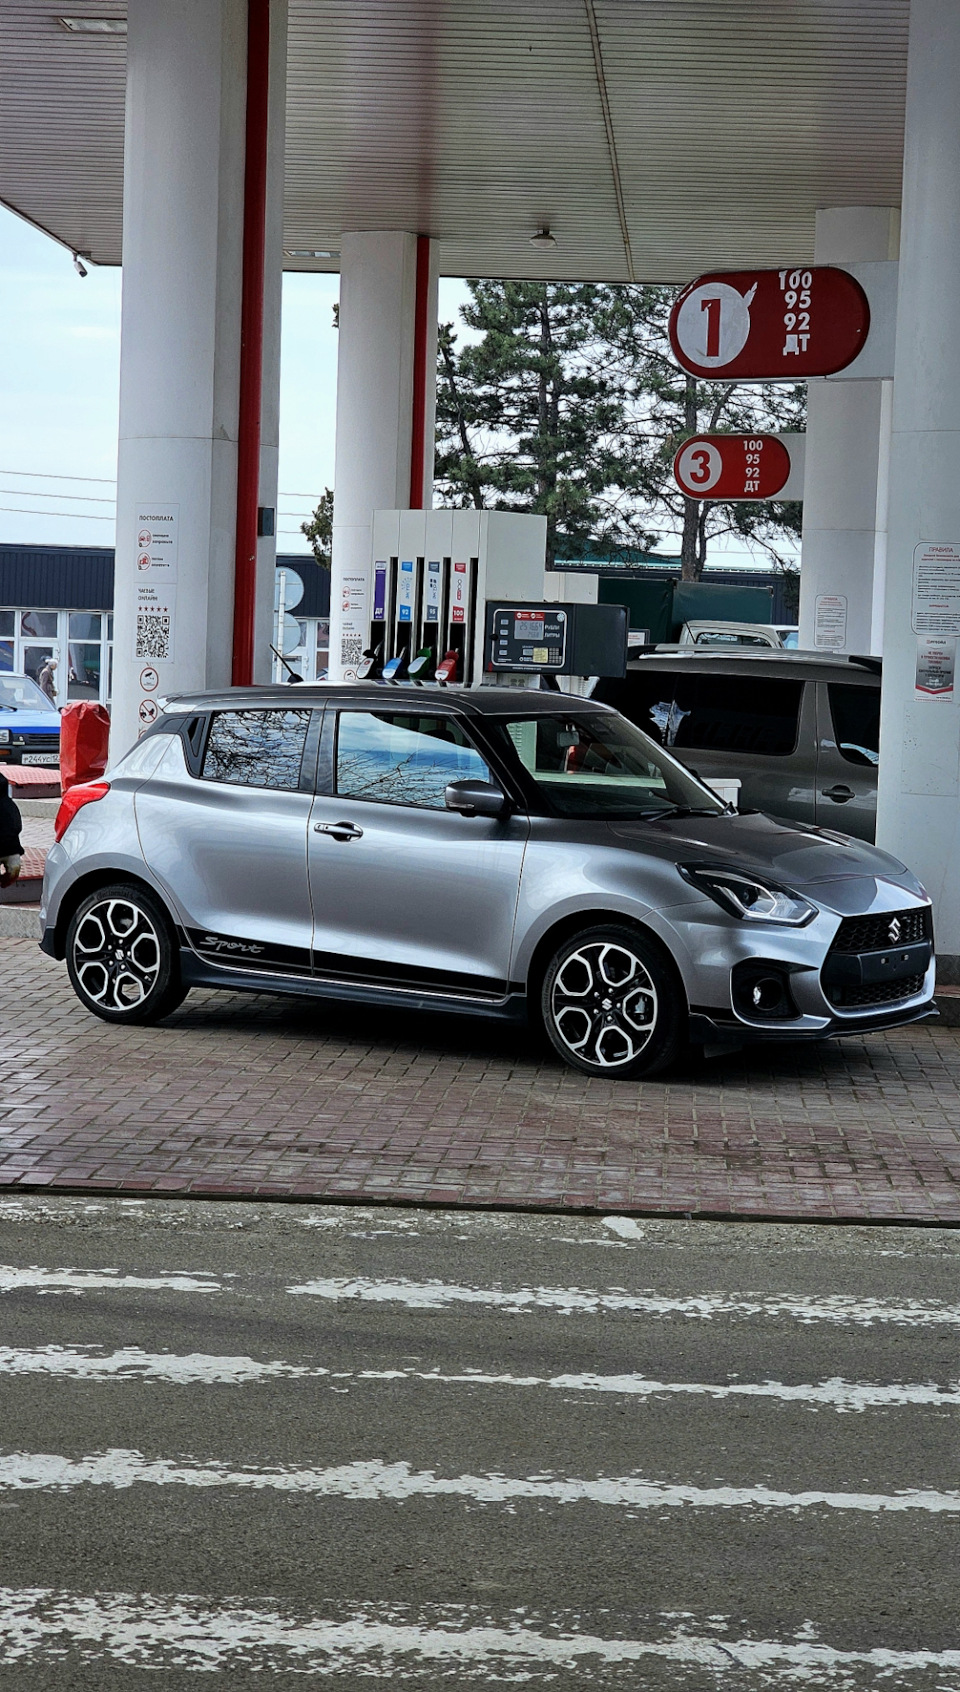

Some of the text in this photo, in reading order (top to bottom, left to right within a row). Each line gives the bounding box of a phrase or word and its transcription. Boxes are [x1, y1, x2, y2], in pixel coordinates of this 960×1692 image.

[778, 269, 813, 290] 100
[784, 290, 812, 309] 95
[700, 298, 721, 357] 1
[783, 312, 811, 331] 92
[782, 333, 811, 356] ДТ
[743, 440, 763, 451] 100
[689, 449, 711, 485] 3
[745, 454, 760, 464] 95
[745, 468, 760, 478] 92
[744, 481, 760, 492] ДТ
[200, 936, 265, 954] Sport
